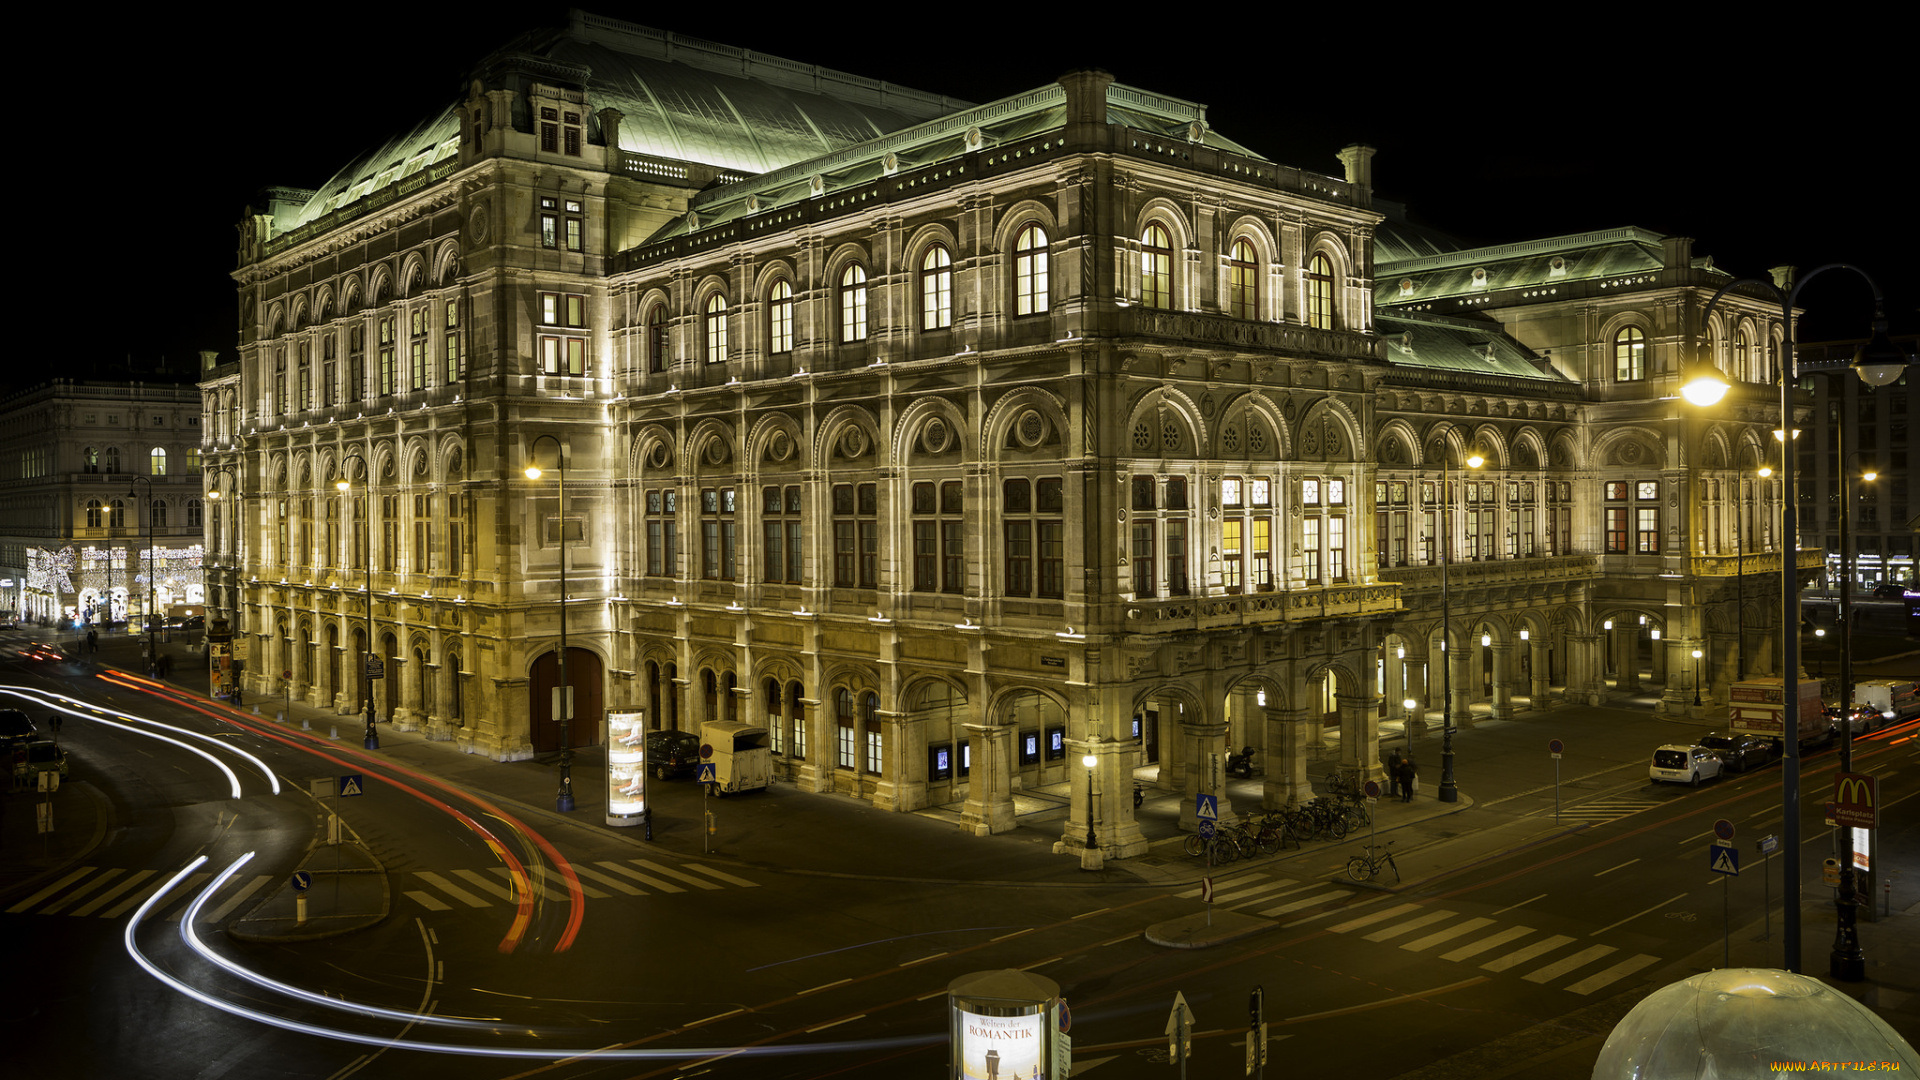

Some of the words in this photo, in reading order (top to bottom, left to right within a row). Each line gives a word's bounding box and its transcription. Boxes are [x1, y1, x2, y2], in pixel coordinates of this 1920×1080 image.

[1836, 808, 1873, 818] Karlsplatz
[980, 1018, 1005, 1028] Welten
[1008, 1020, 1020, 1028] der
[969, 1025, 1032, 1039] ROMANTIK
